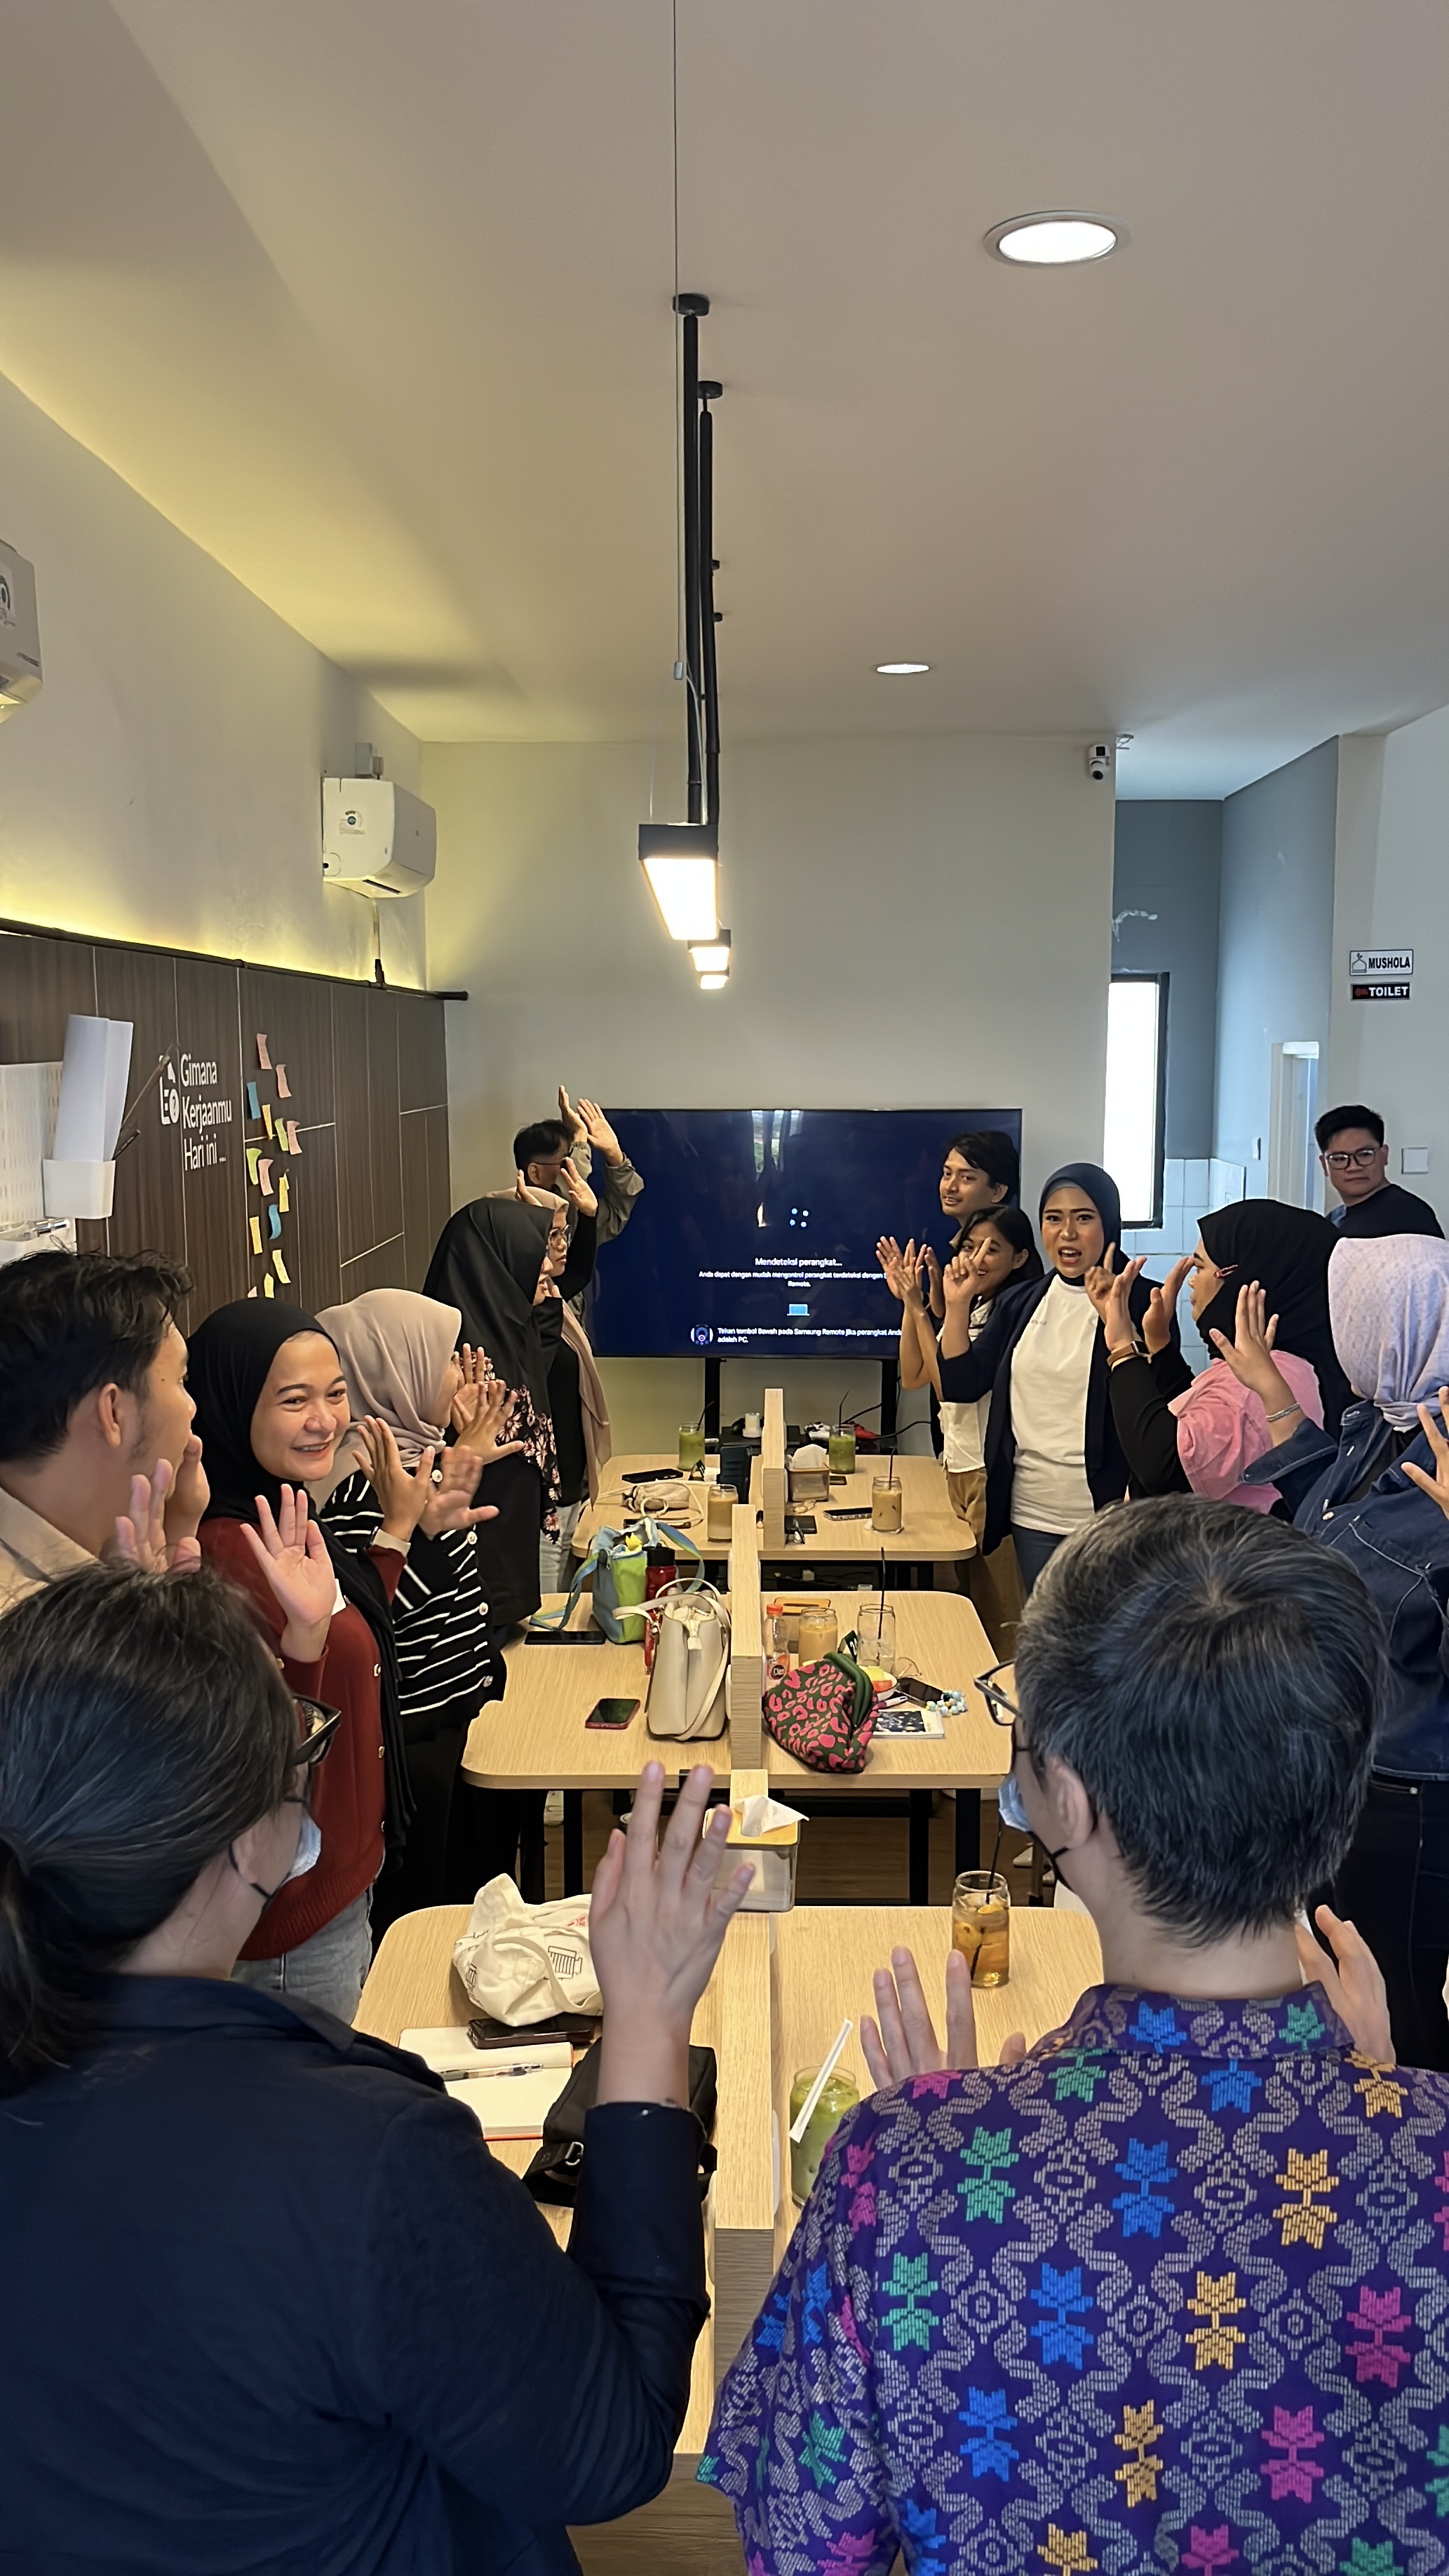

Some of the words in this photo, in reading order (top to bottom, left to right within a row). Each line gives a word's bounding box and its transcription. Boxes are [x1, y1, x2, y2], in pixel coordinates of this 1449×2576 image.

[1368, 957, 1410, 969] MUSHOLA
[1368, 986, 1408, 997] TOILET
[180, 1053, 217, 1087] Gimana
[182, 1094, 232, 1134] Kerjaanmu
[184, 1135, 205, 1172] Hari
[205, 1133, 217, 1166] ini
[755, 1257, 798, 1266] Mendeteksi
[798, 1258, 843, 1268] perangkat...
[714, 1270, 730, 1279] dapat
[794, 1328, 821, 1336] Samsung
[857, 1329, 887, 1337] perangkat
